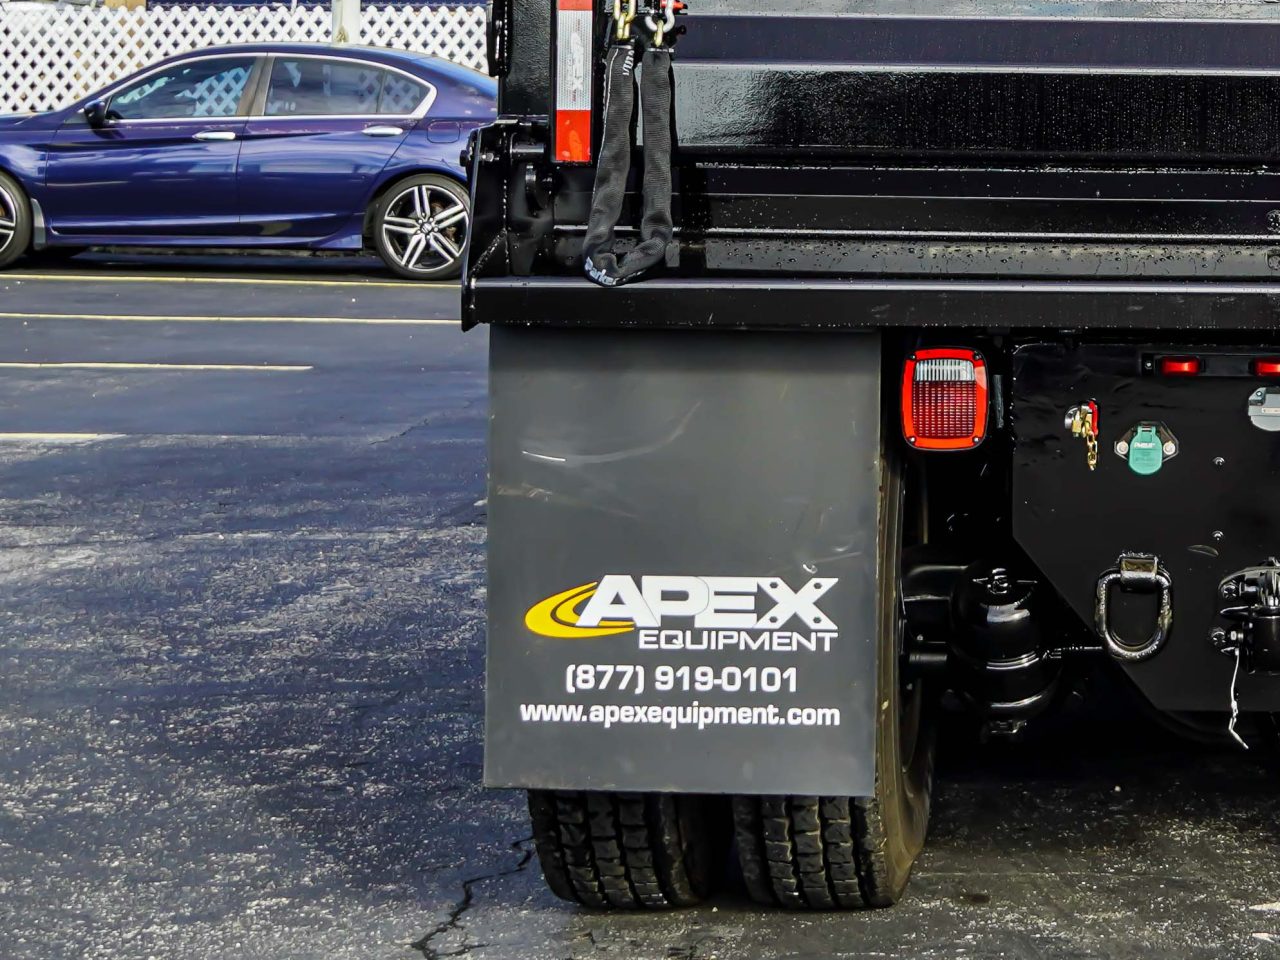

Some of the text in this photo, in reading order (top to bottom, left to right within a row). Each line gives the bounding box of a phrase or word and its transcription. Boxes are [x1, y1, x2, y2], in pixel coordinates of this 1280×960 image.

[575, 574, 839, 630] APEX
[638, 630, 838, 652] EQUIPMENT
[565, 663, 798, 694] (877) 919-0101
[520, 700, 841, 730] www.apexequipment.com
